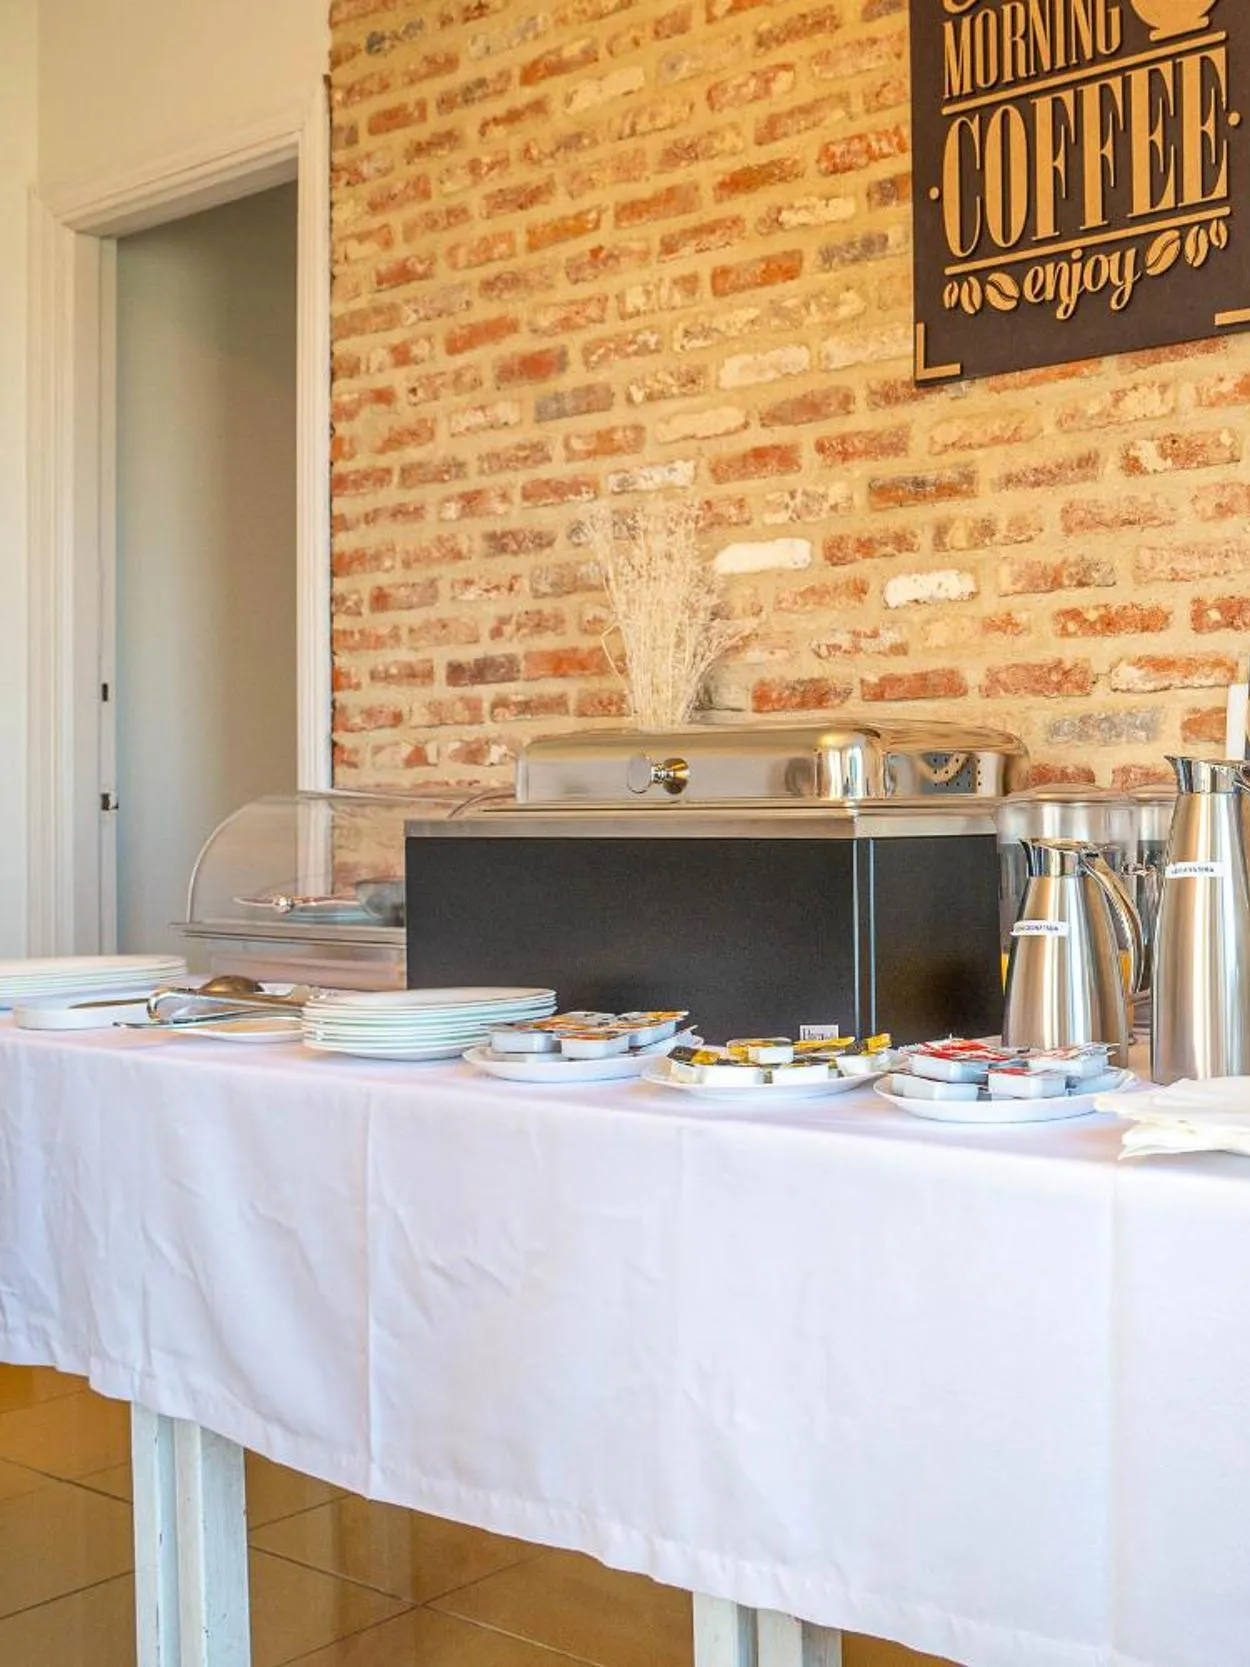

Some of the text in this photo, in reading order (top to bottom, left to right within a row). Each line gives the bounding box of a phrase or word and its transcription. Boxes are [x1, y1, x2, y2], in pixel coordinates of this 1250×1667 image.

[943, 0, 1122, 99] MORNING
[942, 46, 1229, 258] COFFEE
[1023, 247, 1141, 320] enjoy
